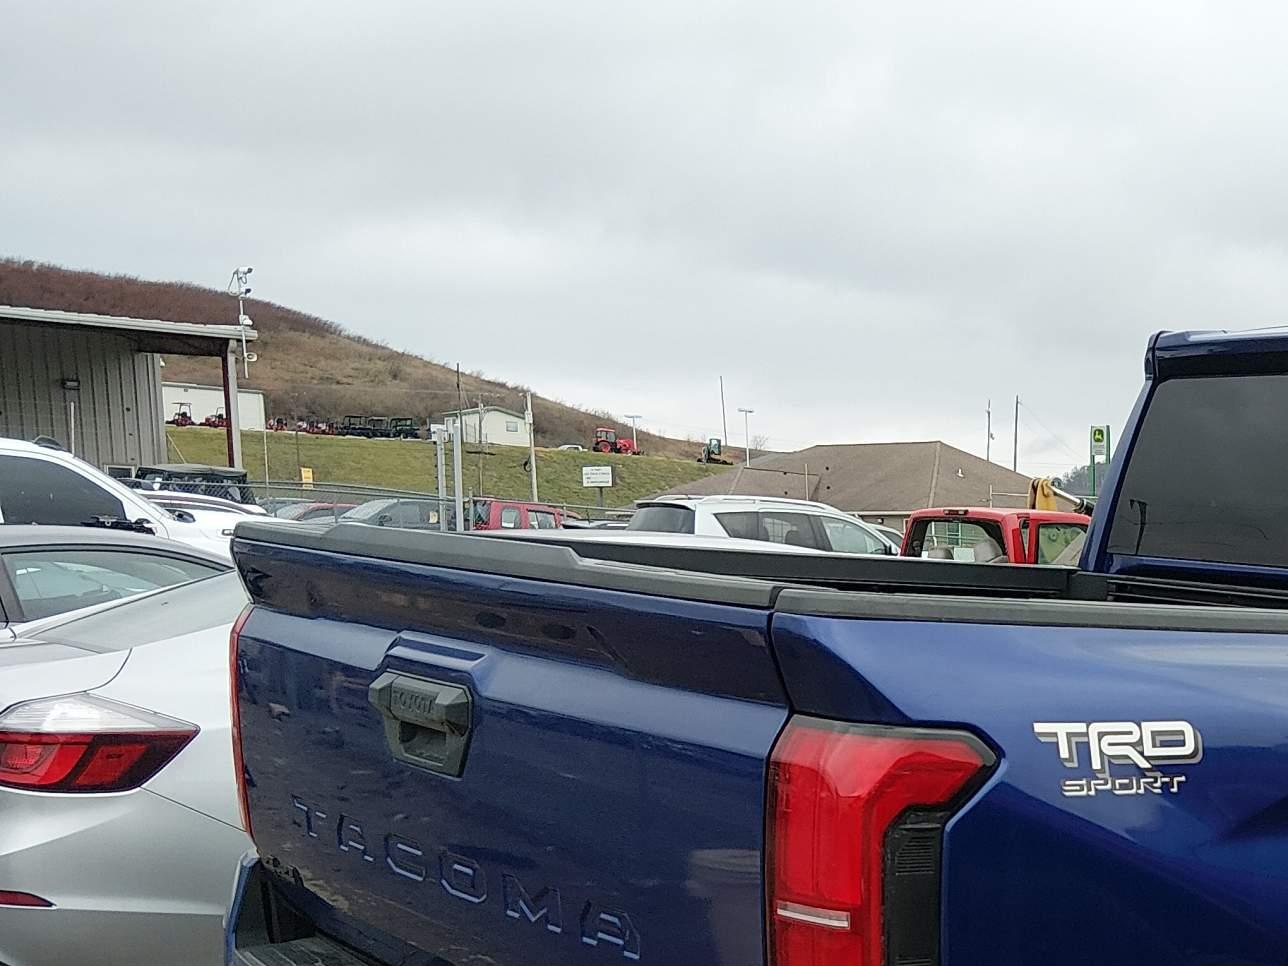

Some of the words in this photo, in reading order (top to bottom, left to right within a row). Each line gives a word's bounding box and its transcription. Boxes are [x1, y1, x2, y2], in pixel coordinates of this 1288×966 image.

[1033, 720, 1203, 773] TRD
[1061, 775, 1187, 797] SPORT
[290, 794, 641, 961] TACOMA
